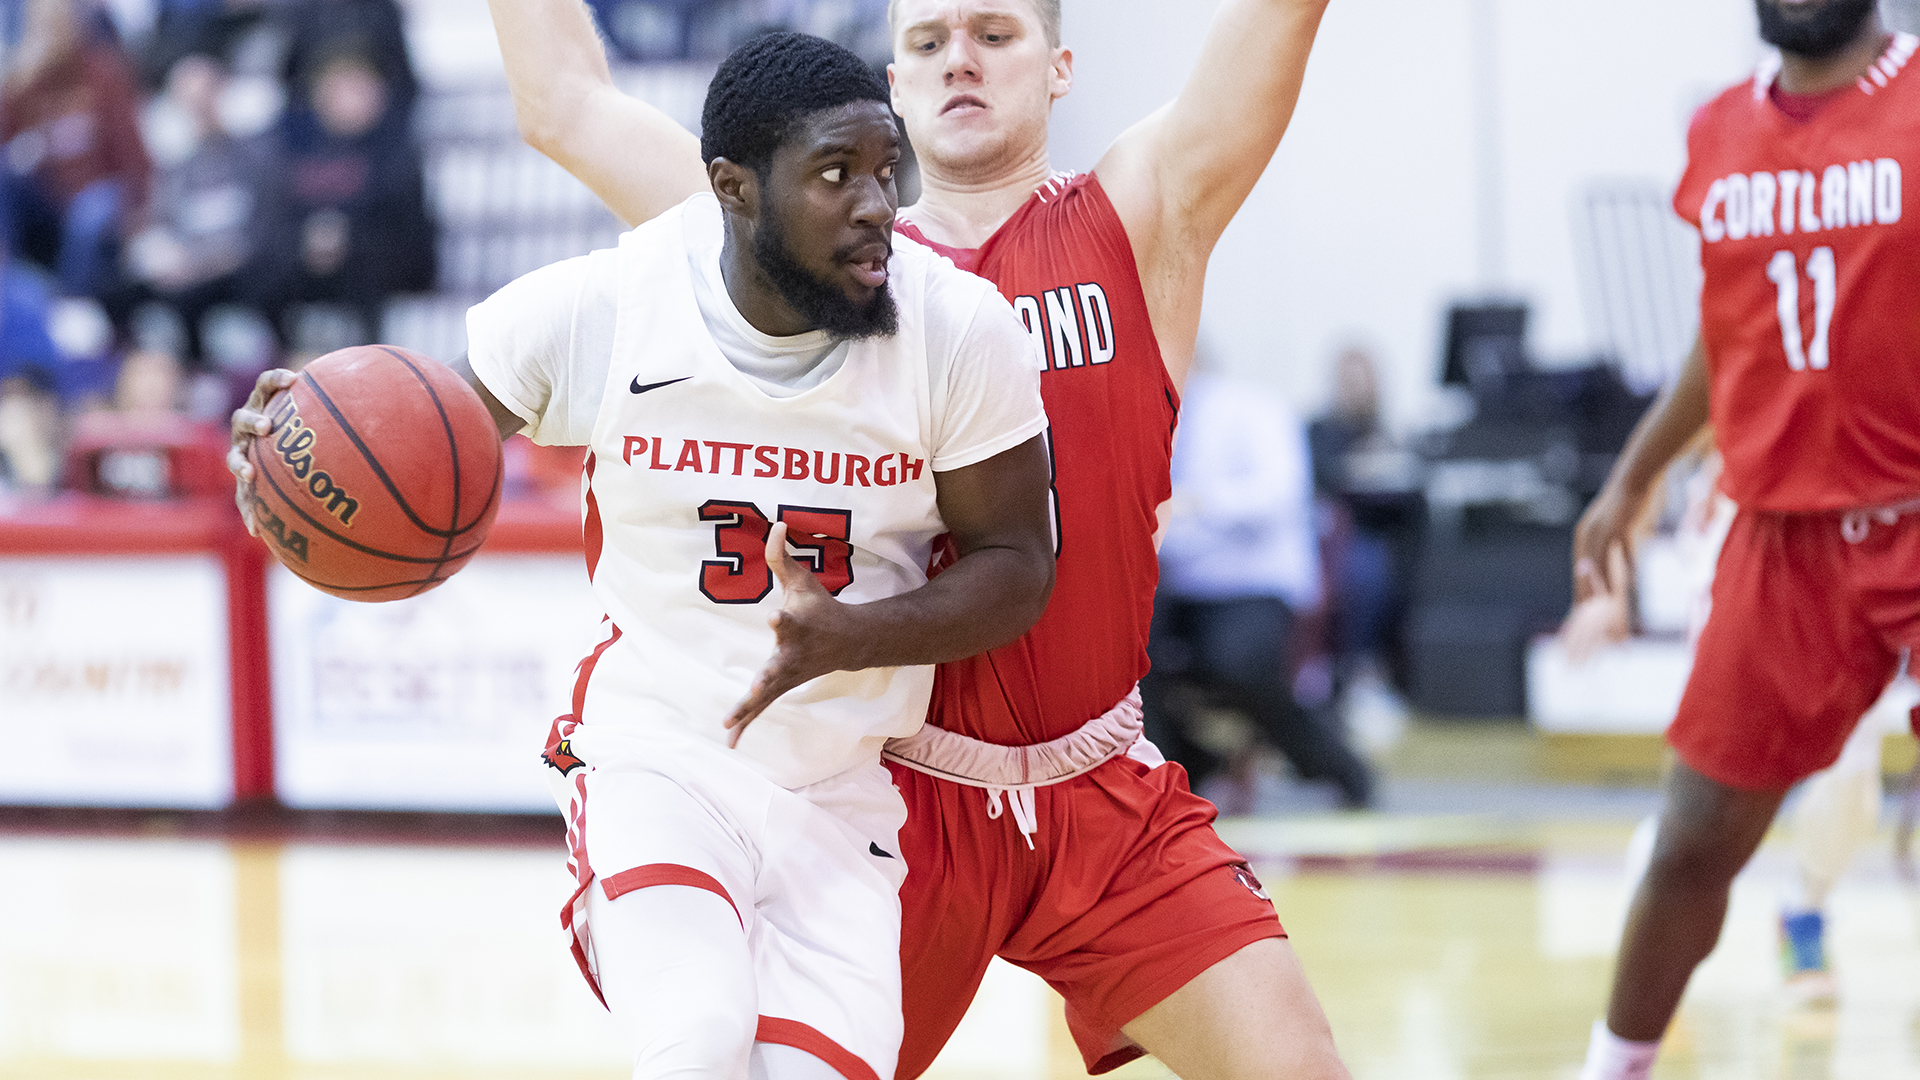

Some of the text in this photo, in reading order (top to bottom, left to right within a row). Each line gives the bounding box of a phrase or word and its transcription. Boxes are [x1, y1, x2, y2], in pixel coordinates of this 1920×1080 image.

[1701, 157, 1902, 243] CORTLAND
[1766, 246, 1836, 371] 11
[622, 435, 924, 487] PLATTSBURGH
[253, 494, 309, 564] CAA
[697, 499, 854, 604] 35
